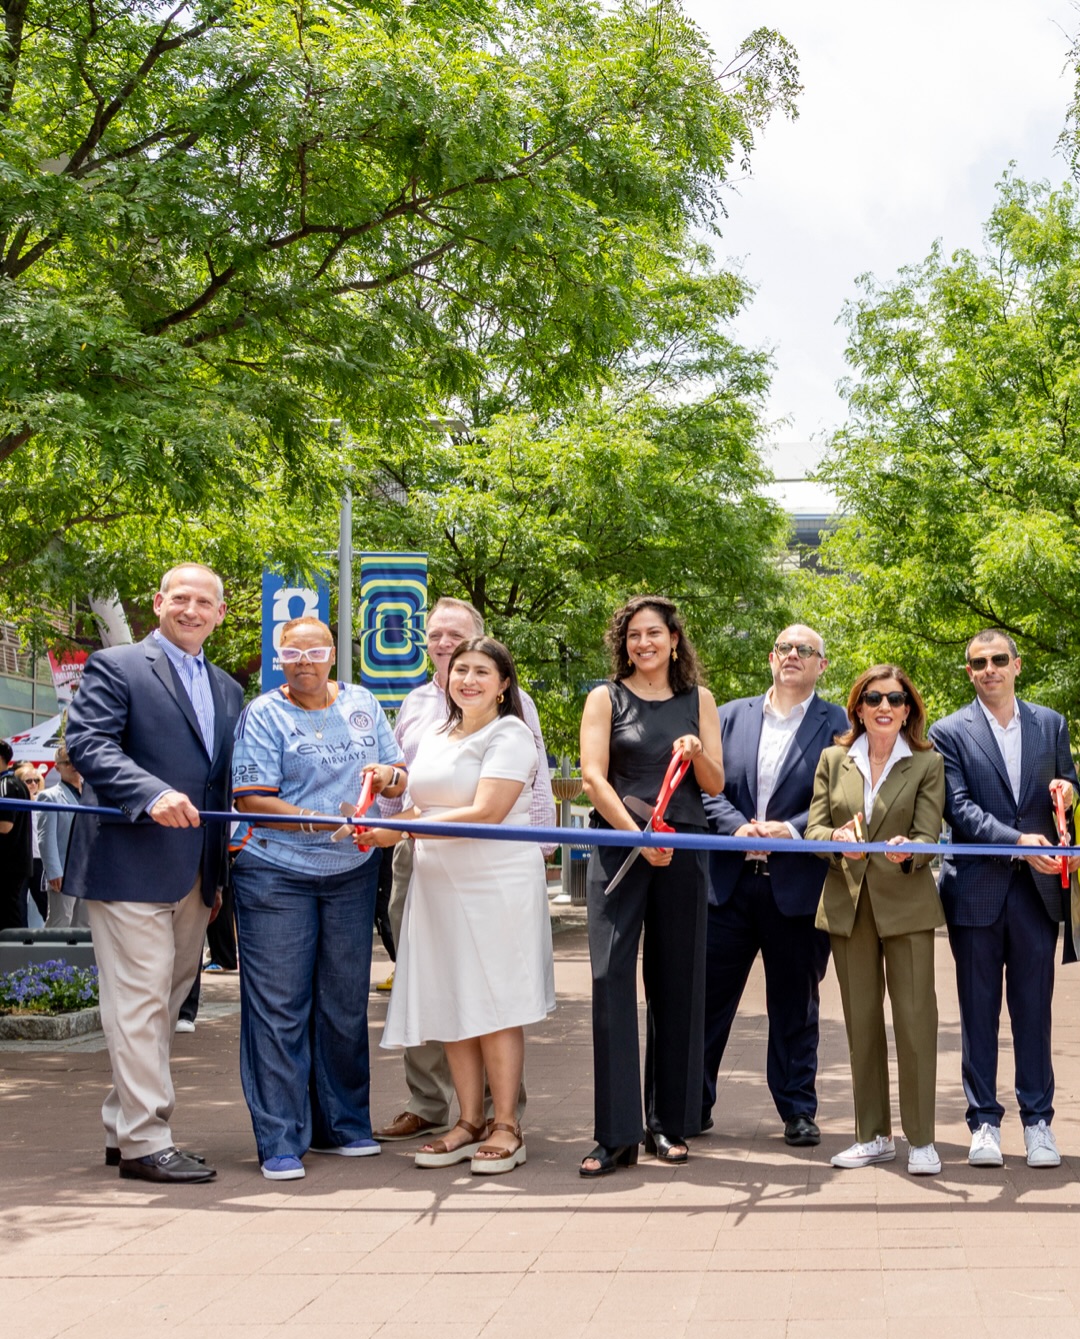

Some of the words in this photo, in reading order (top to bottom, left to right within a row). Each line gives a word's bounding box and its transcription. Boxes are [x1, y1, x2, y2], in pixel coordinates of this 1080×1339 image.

[296, 735, 376, 756] ETIHAD
[321, 751, 367, 765] AIRWAYS
[234, 774, 258, 783] PES
